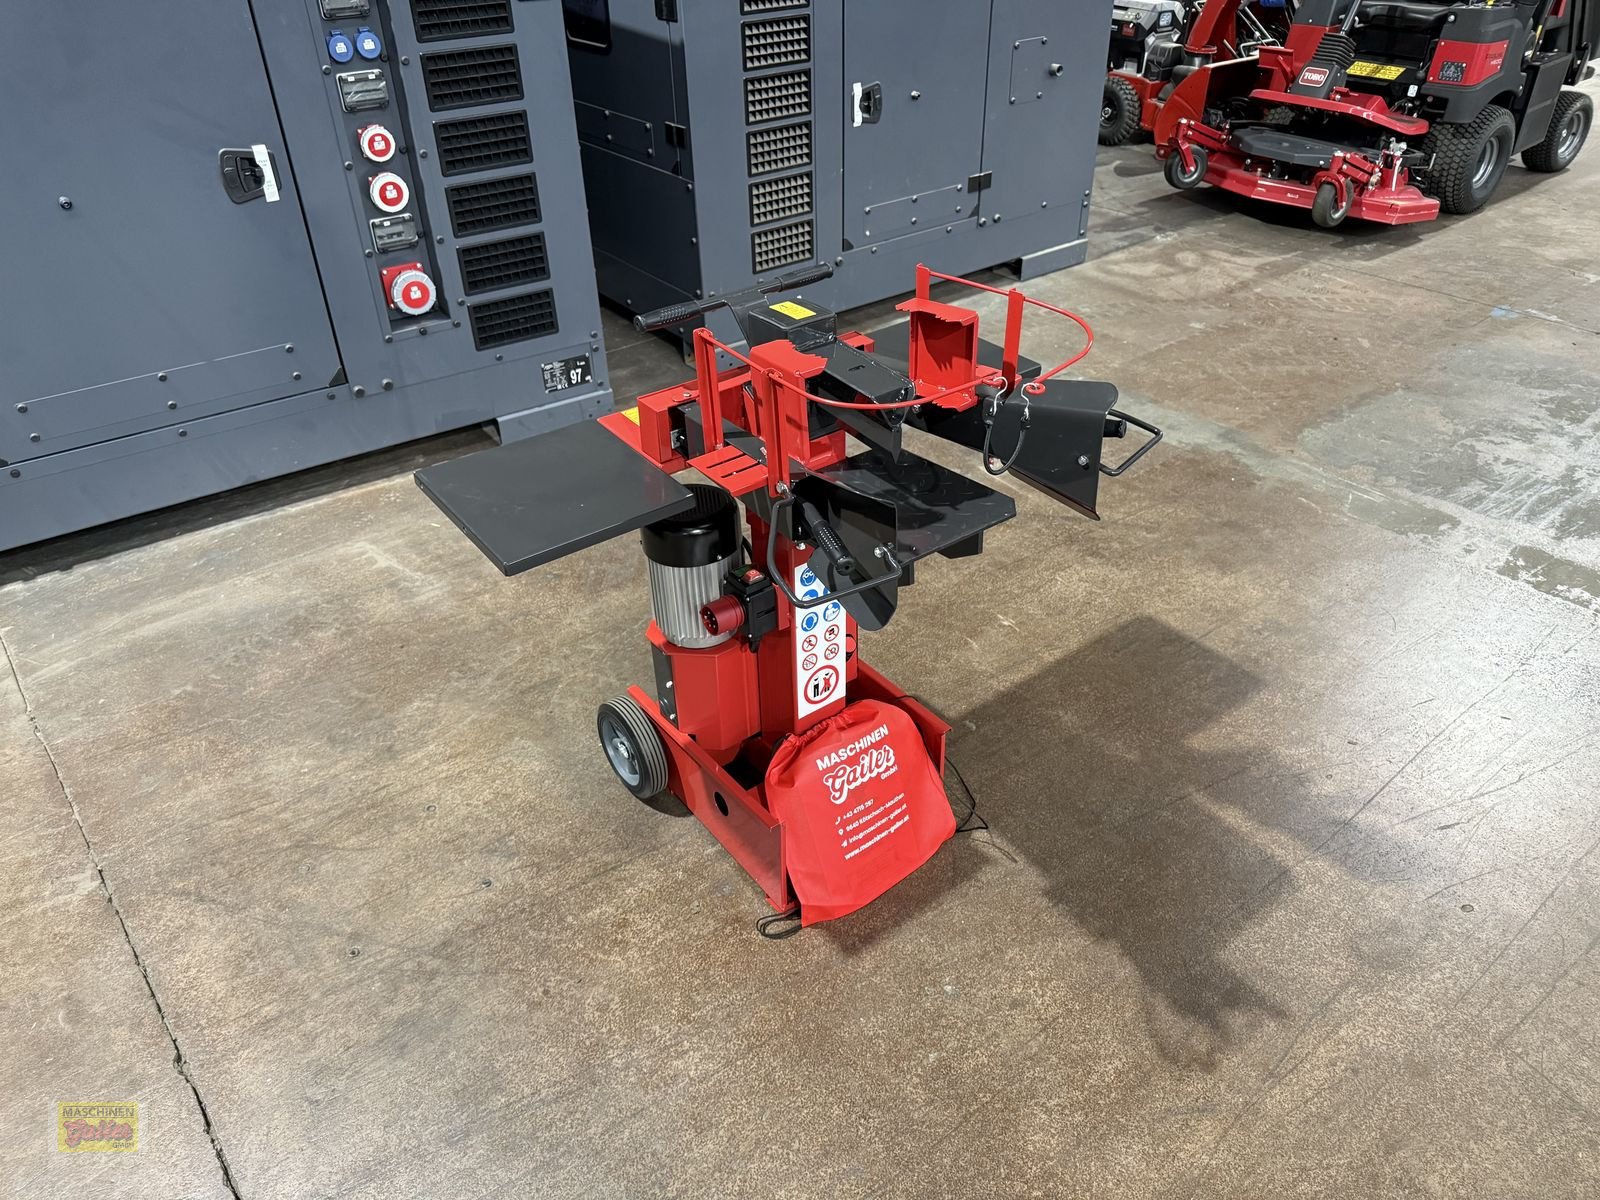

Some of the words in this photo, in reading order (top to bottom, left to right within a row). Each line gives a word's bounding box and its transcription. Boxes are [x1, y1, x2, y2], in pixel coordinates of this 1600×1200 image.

[1303, 72, 1325, 82] TORO
[570, 368, 582, 384] 97
[815, 723, 889, 771] MASCHINEN
[823, 745, 896, 805] Gailer
[880, 764, 898, 780] GmbH
[844, 814, 910, 860] www.maschinen-gailer.at
[849, 803, 907, 843] info@maschinen-gailer.at
